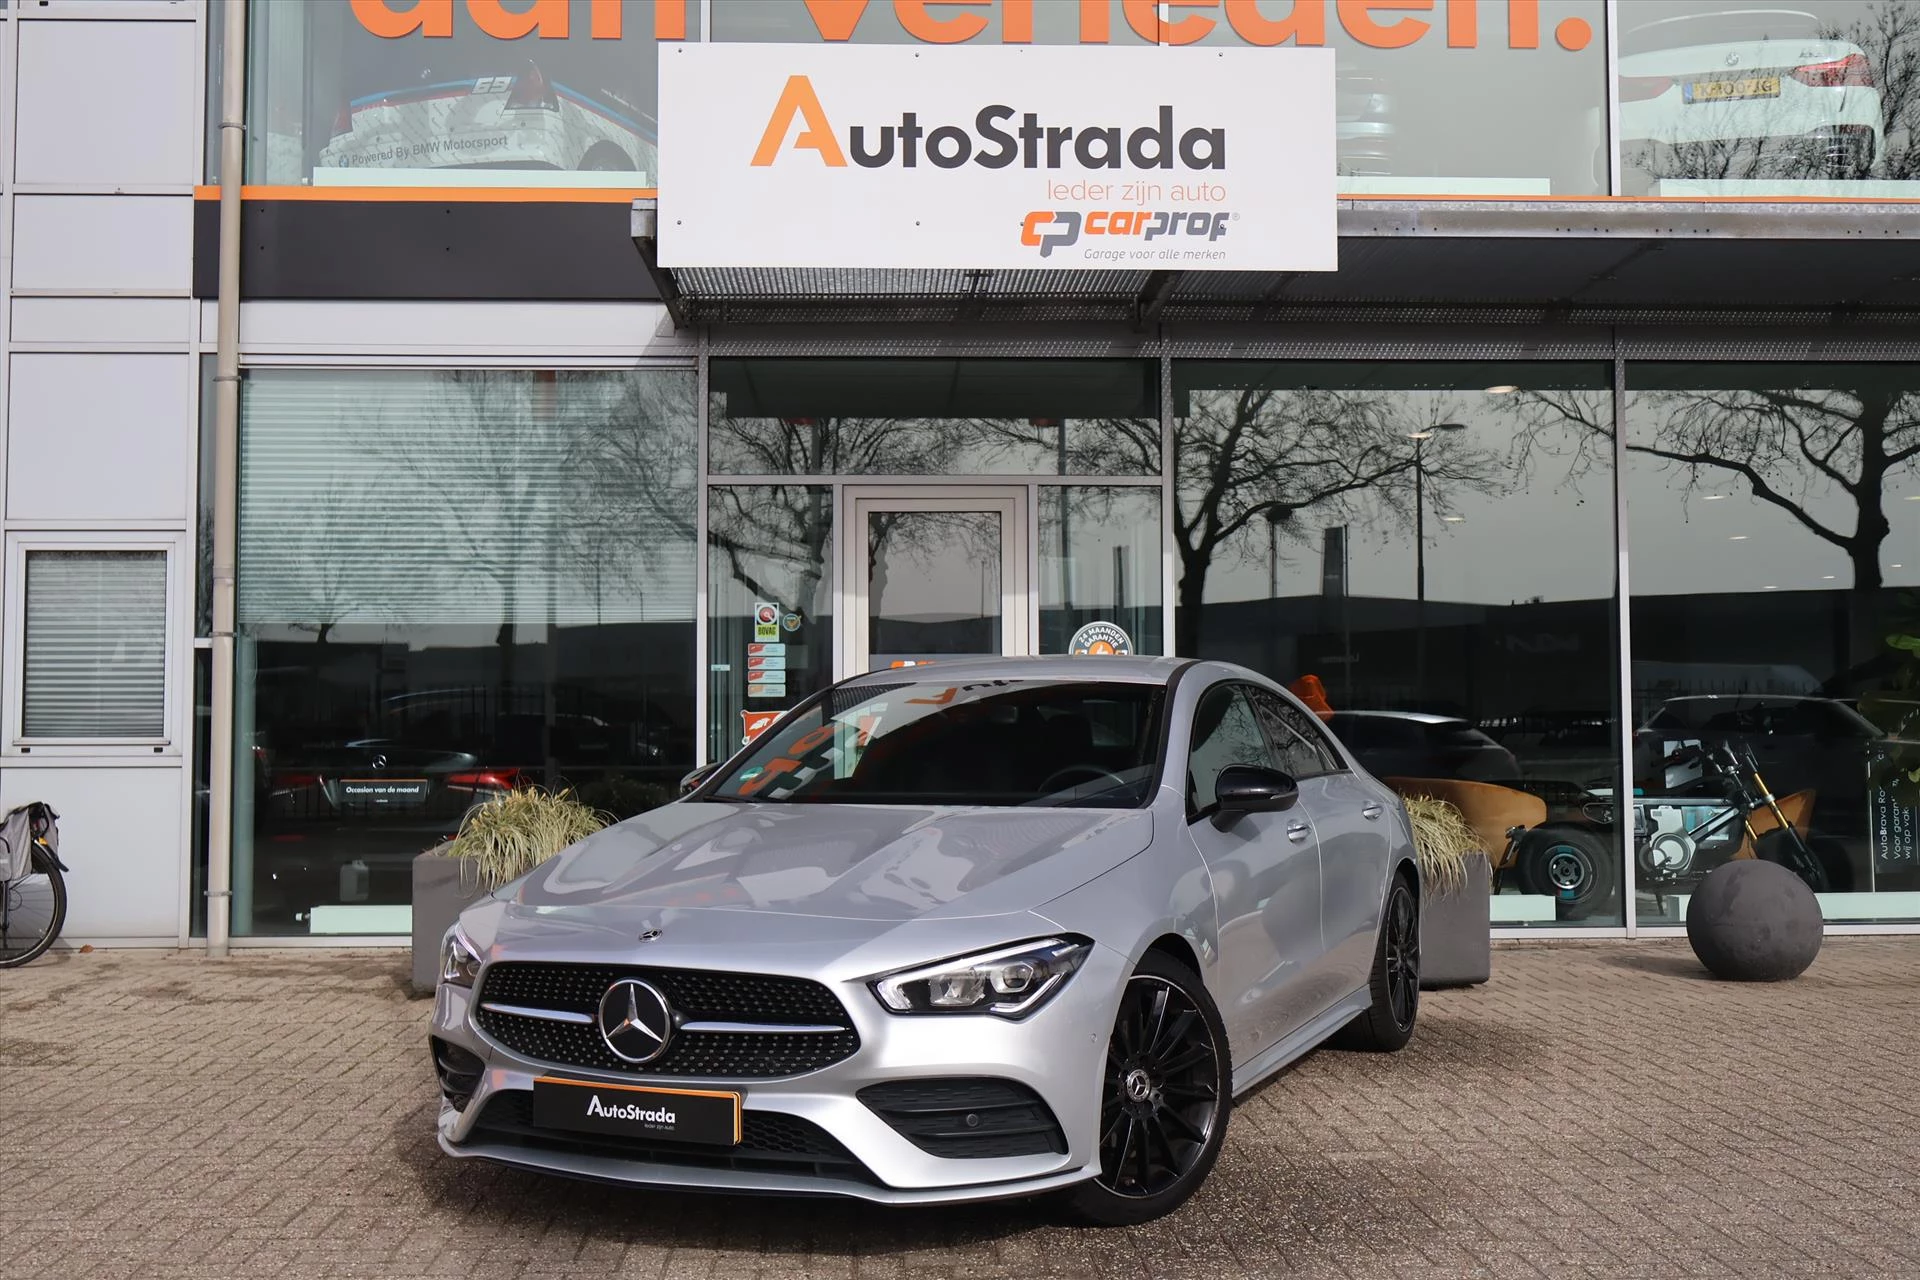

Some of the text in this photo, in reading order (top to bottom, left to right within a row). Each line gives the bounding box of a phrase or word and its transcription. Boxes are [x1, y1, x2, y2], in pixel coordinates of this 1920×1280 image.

[472, 76, 512, 94] 69
[750, 75, 1226, 170] AutoStrada
[352, 135, 508, 165] Powered By BMW Motorsport
[1048, 179, 1226, 206] Ieder zijn auto
[1084, 249, 1226, 262] Garage voor alle merken
[757, 626, 777, 636] BOVAG
[1078, 626, 1125, 645] 24 MAANDEN
[1084, 634, 1119, 649] GARANTIE
[345, 785, 374, 794] Occasion
[387, 785, 396, 794] de
[396, 785, 420, 794] maand
[1879, 806, 1889, 860] AutoBrava
[1904, 829, 1912, 844] op
[1893, 835, 1901, 860] Voor
[1903, 845, 1913, 860] wij
[586, 1094, 676, 1124] AutoStrada
